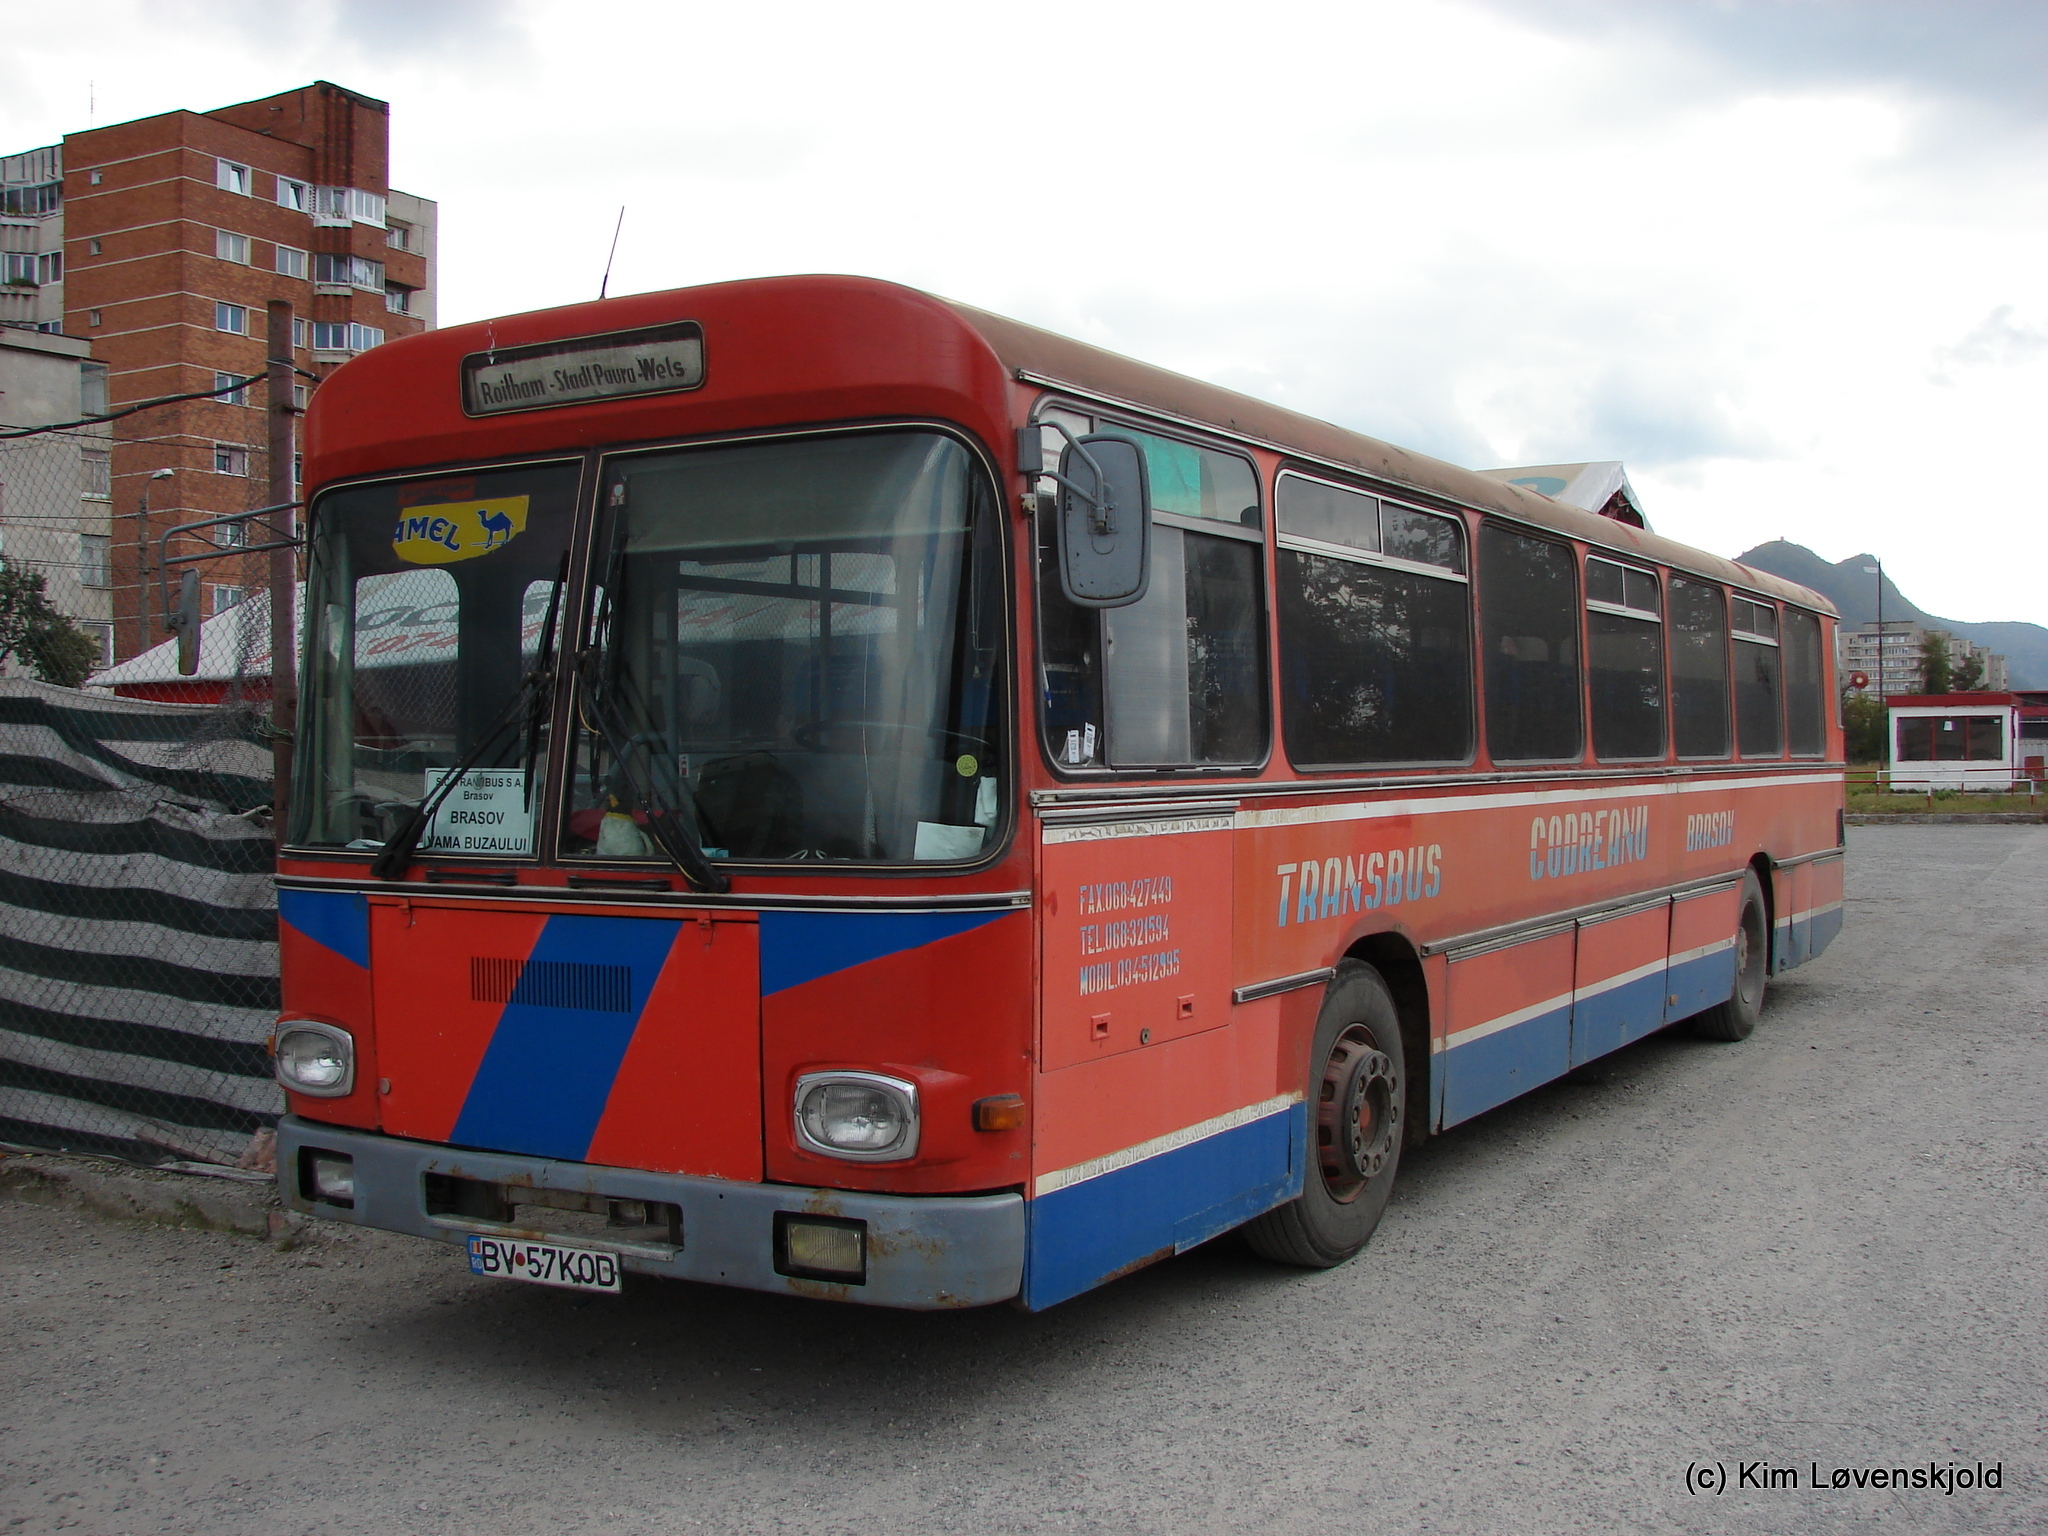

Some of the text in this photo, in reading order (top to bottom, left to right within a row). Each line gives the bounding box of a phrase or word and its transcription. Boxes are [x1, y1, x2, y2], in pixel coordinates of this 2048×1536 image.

[1276, 806, 1735, 927] TRANSBUS CODREANU BRASOV
[482, 1241, 516, 1274] BV
